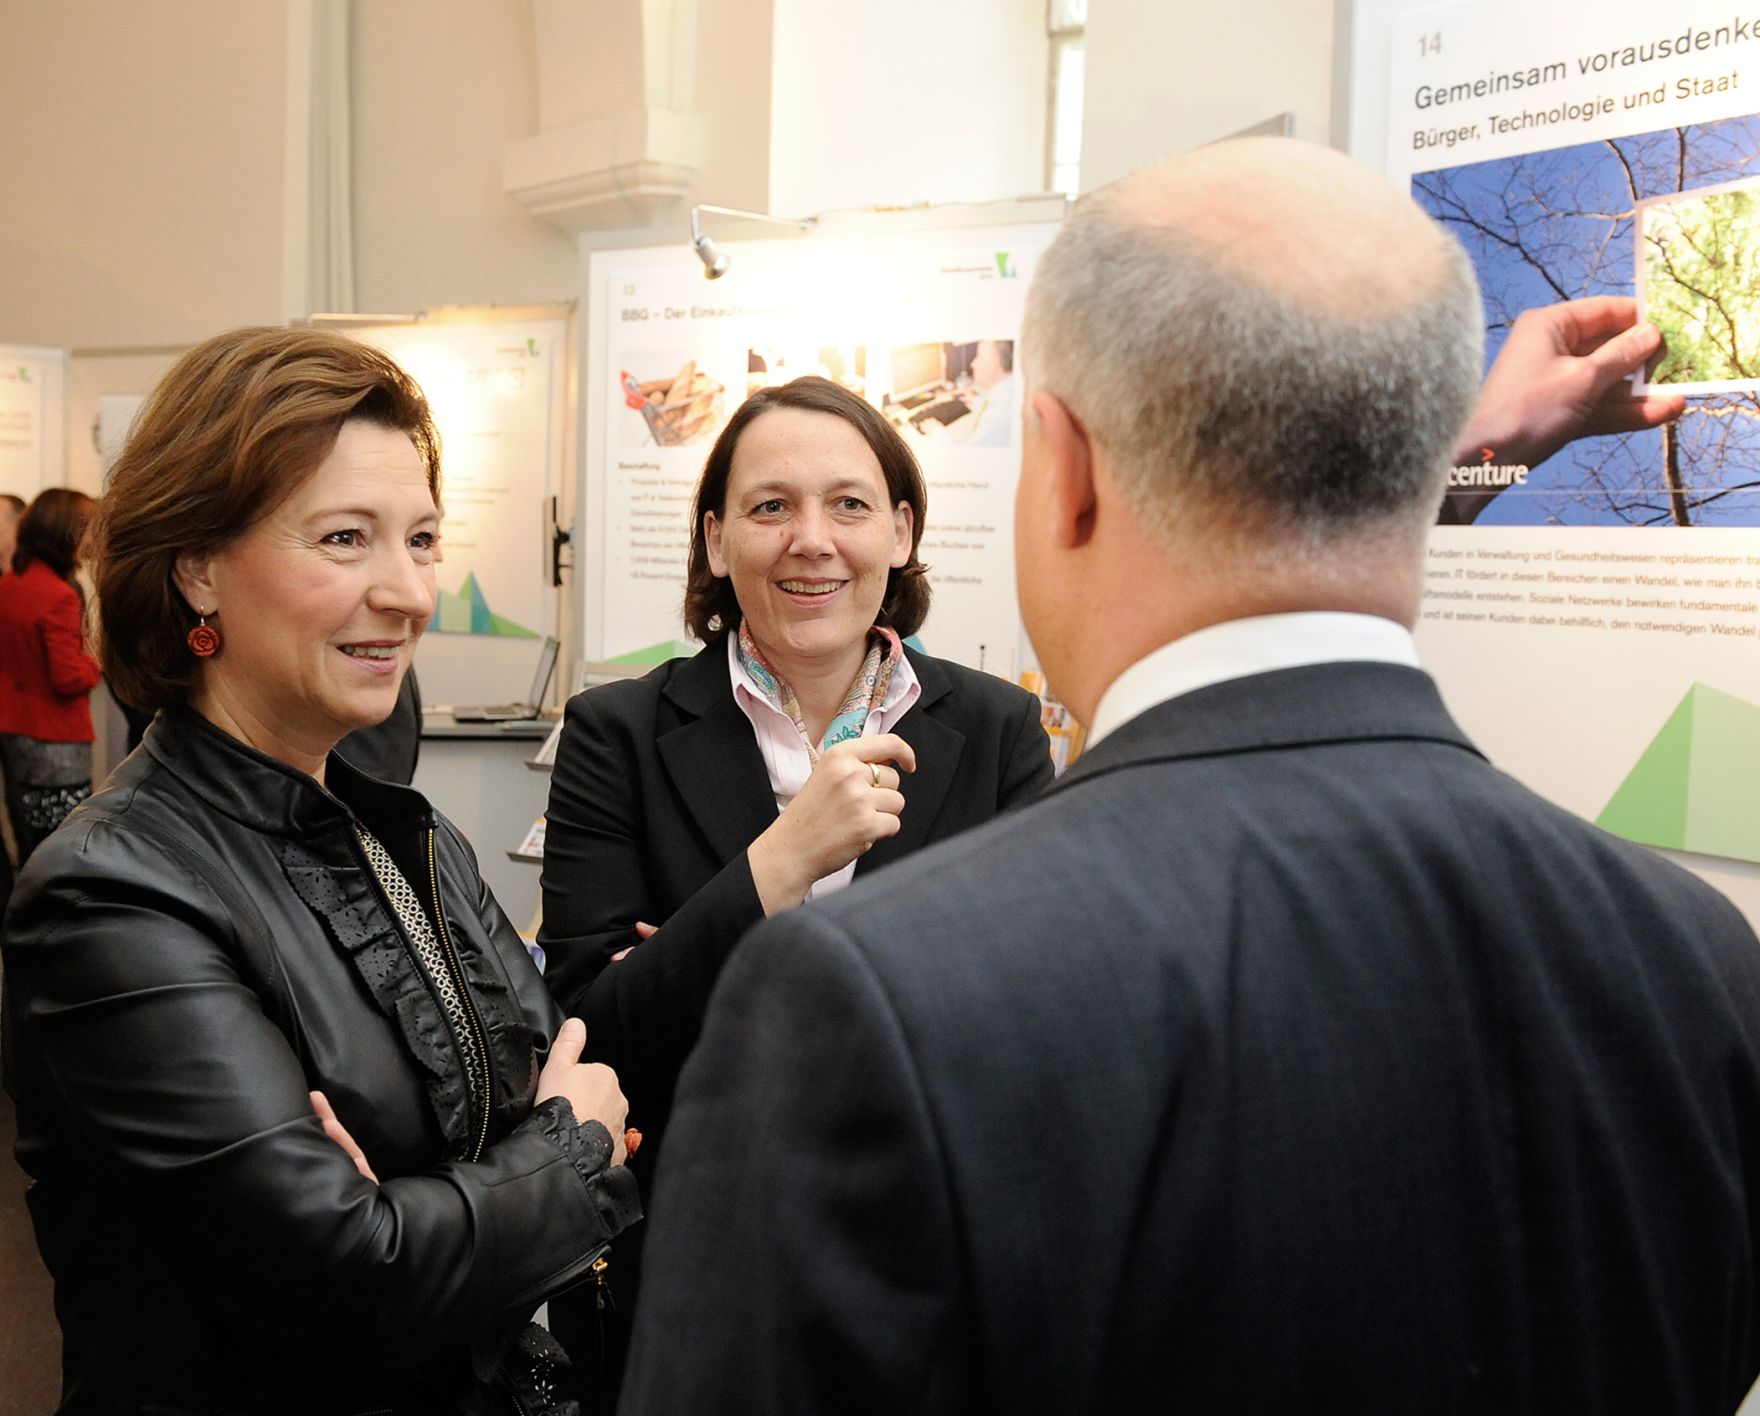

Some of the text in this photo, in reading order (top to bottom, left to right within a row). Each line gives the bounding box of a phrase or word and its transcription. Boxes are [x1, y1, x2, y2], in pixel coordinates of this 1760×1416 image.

[1418, 32, 1442, 57] 14
[1414, 62, 1567, 110] Gemeinsam
[1413, 70, 1739, 151] Bürger, Technologie und Staat
[664, 306, 687, 320] Der
[1428, 548, 1464, 559] Kunden
[1466, 550, 1475, 560] in
[1477, 549, 1531, 562] Verwaltung
[1533, 551, 1552, 562] und
[1555, 550, 1657, 563] Gesundheitswesen
[1660, 552, 1744, 566] repräsentieren
[1455, 568, 1464, 579] IT
[1466, 569, 1498, 580] fördert
[1500, 570, 1509, 581] in
[1511, 571, 1544, 582] diesen
[1547, 571, 1599, 584] Bereichen
[1602, 573, 1631, 585] einen
[1635, 573, 1680, 588] Wandel,
[1683, 576, 1703, 587] wie
[1706, 578, 1732, 588] man
[1735, 577, 1752, 589] ihn
[1529, 592, 1564, 605] Soziale
[1568, 593, 1624, 607] Netzwerke
[1627, 596, 1677, 609] bewirken
[1680, 599, 1758, 613] fundamentale
[1423, 610, 1441, 619] und
[1456, 612, 1486, 621] seinen
[1489, 611, 1526, 623] Kunden
[1529, 614, 1556, 626] dabei
[1610, 618, 1631, 630] den
[1634, 620, 1707, 636] notwendigen
[1711, 623, 1756, 637] Wandel
